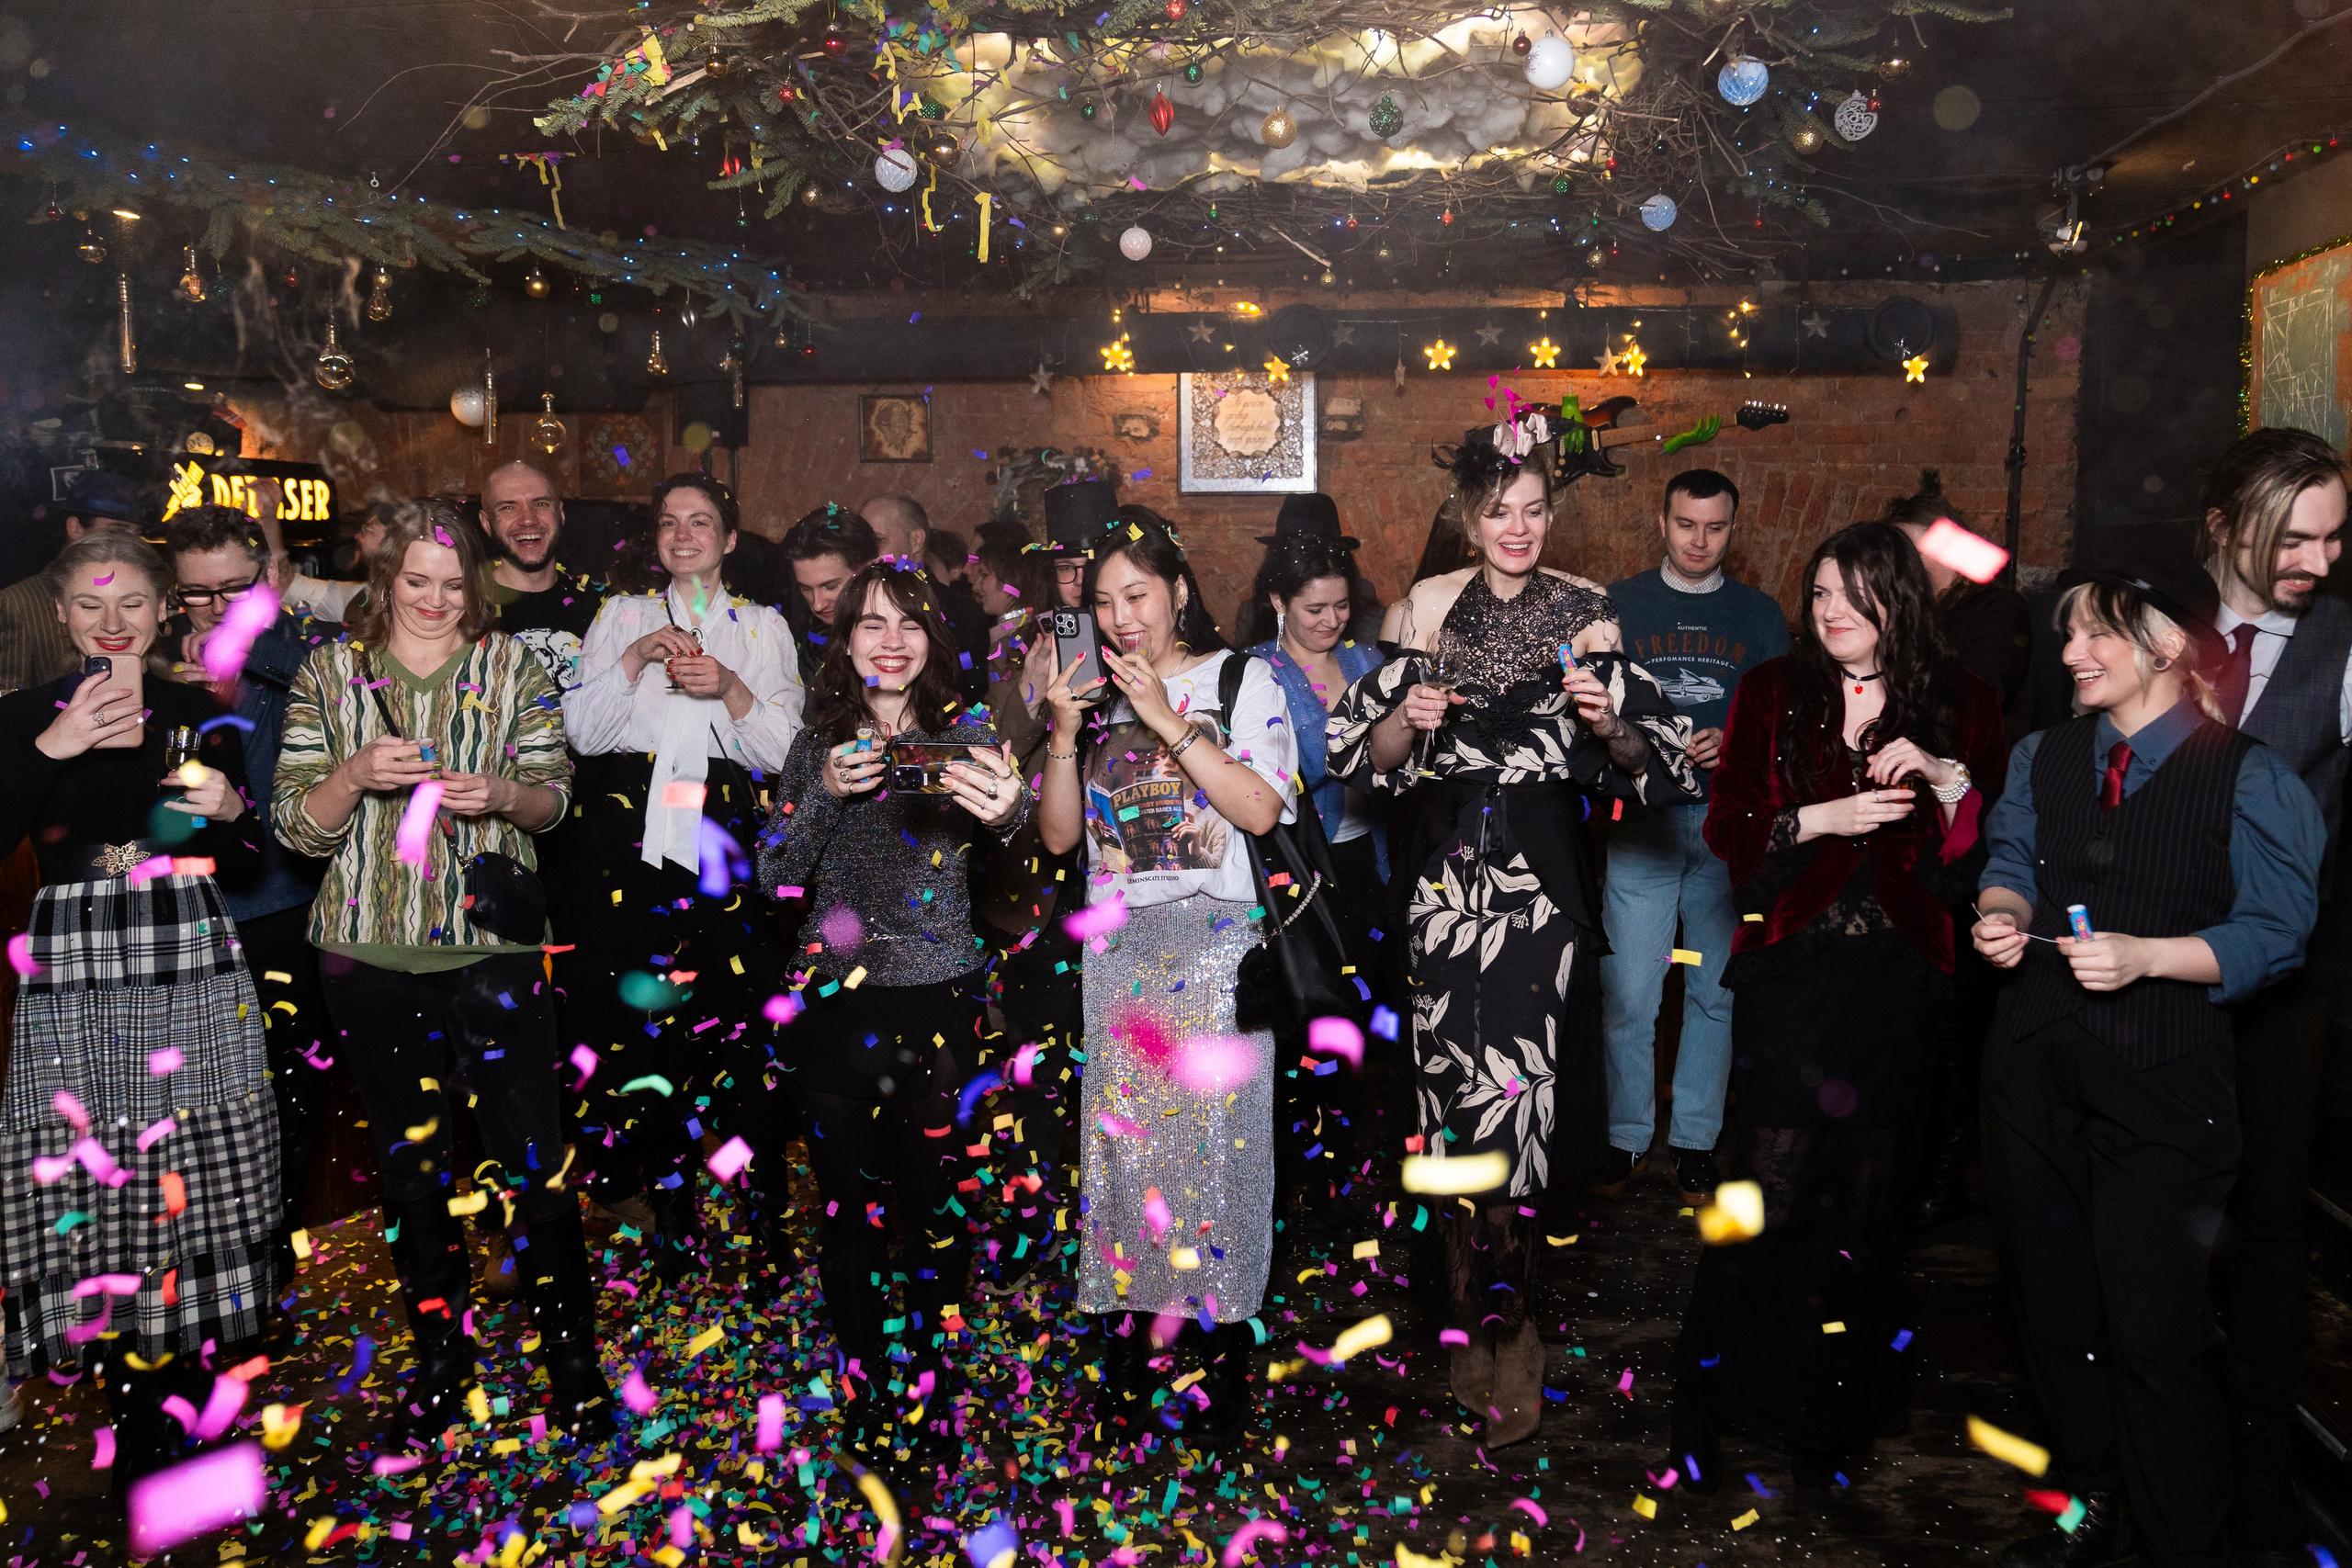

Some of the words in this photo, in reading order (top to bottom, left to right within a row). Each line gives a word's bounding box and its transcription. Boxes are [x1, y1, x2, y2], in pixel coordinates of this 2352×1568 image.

[210, 473, 330, 521] DESER
[1635, 633, 1747, 665] FREEDOM
[1697, 657, 1729, 667] HERITAGE
[1113, 782, 1182, 808] PLAYBOY
